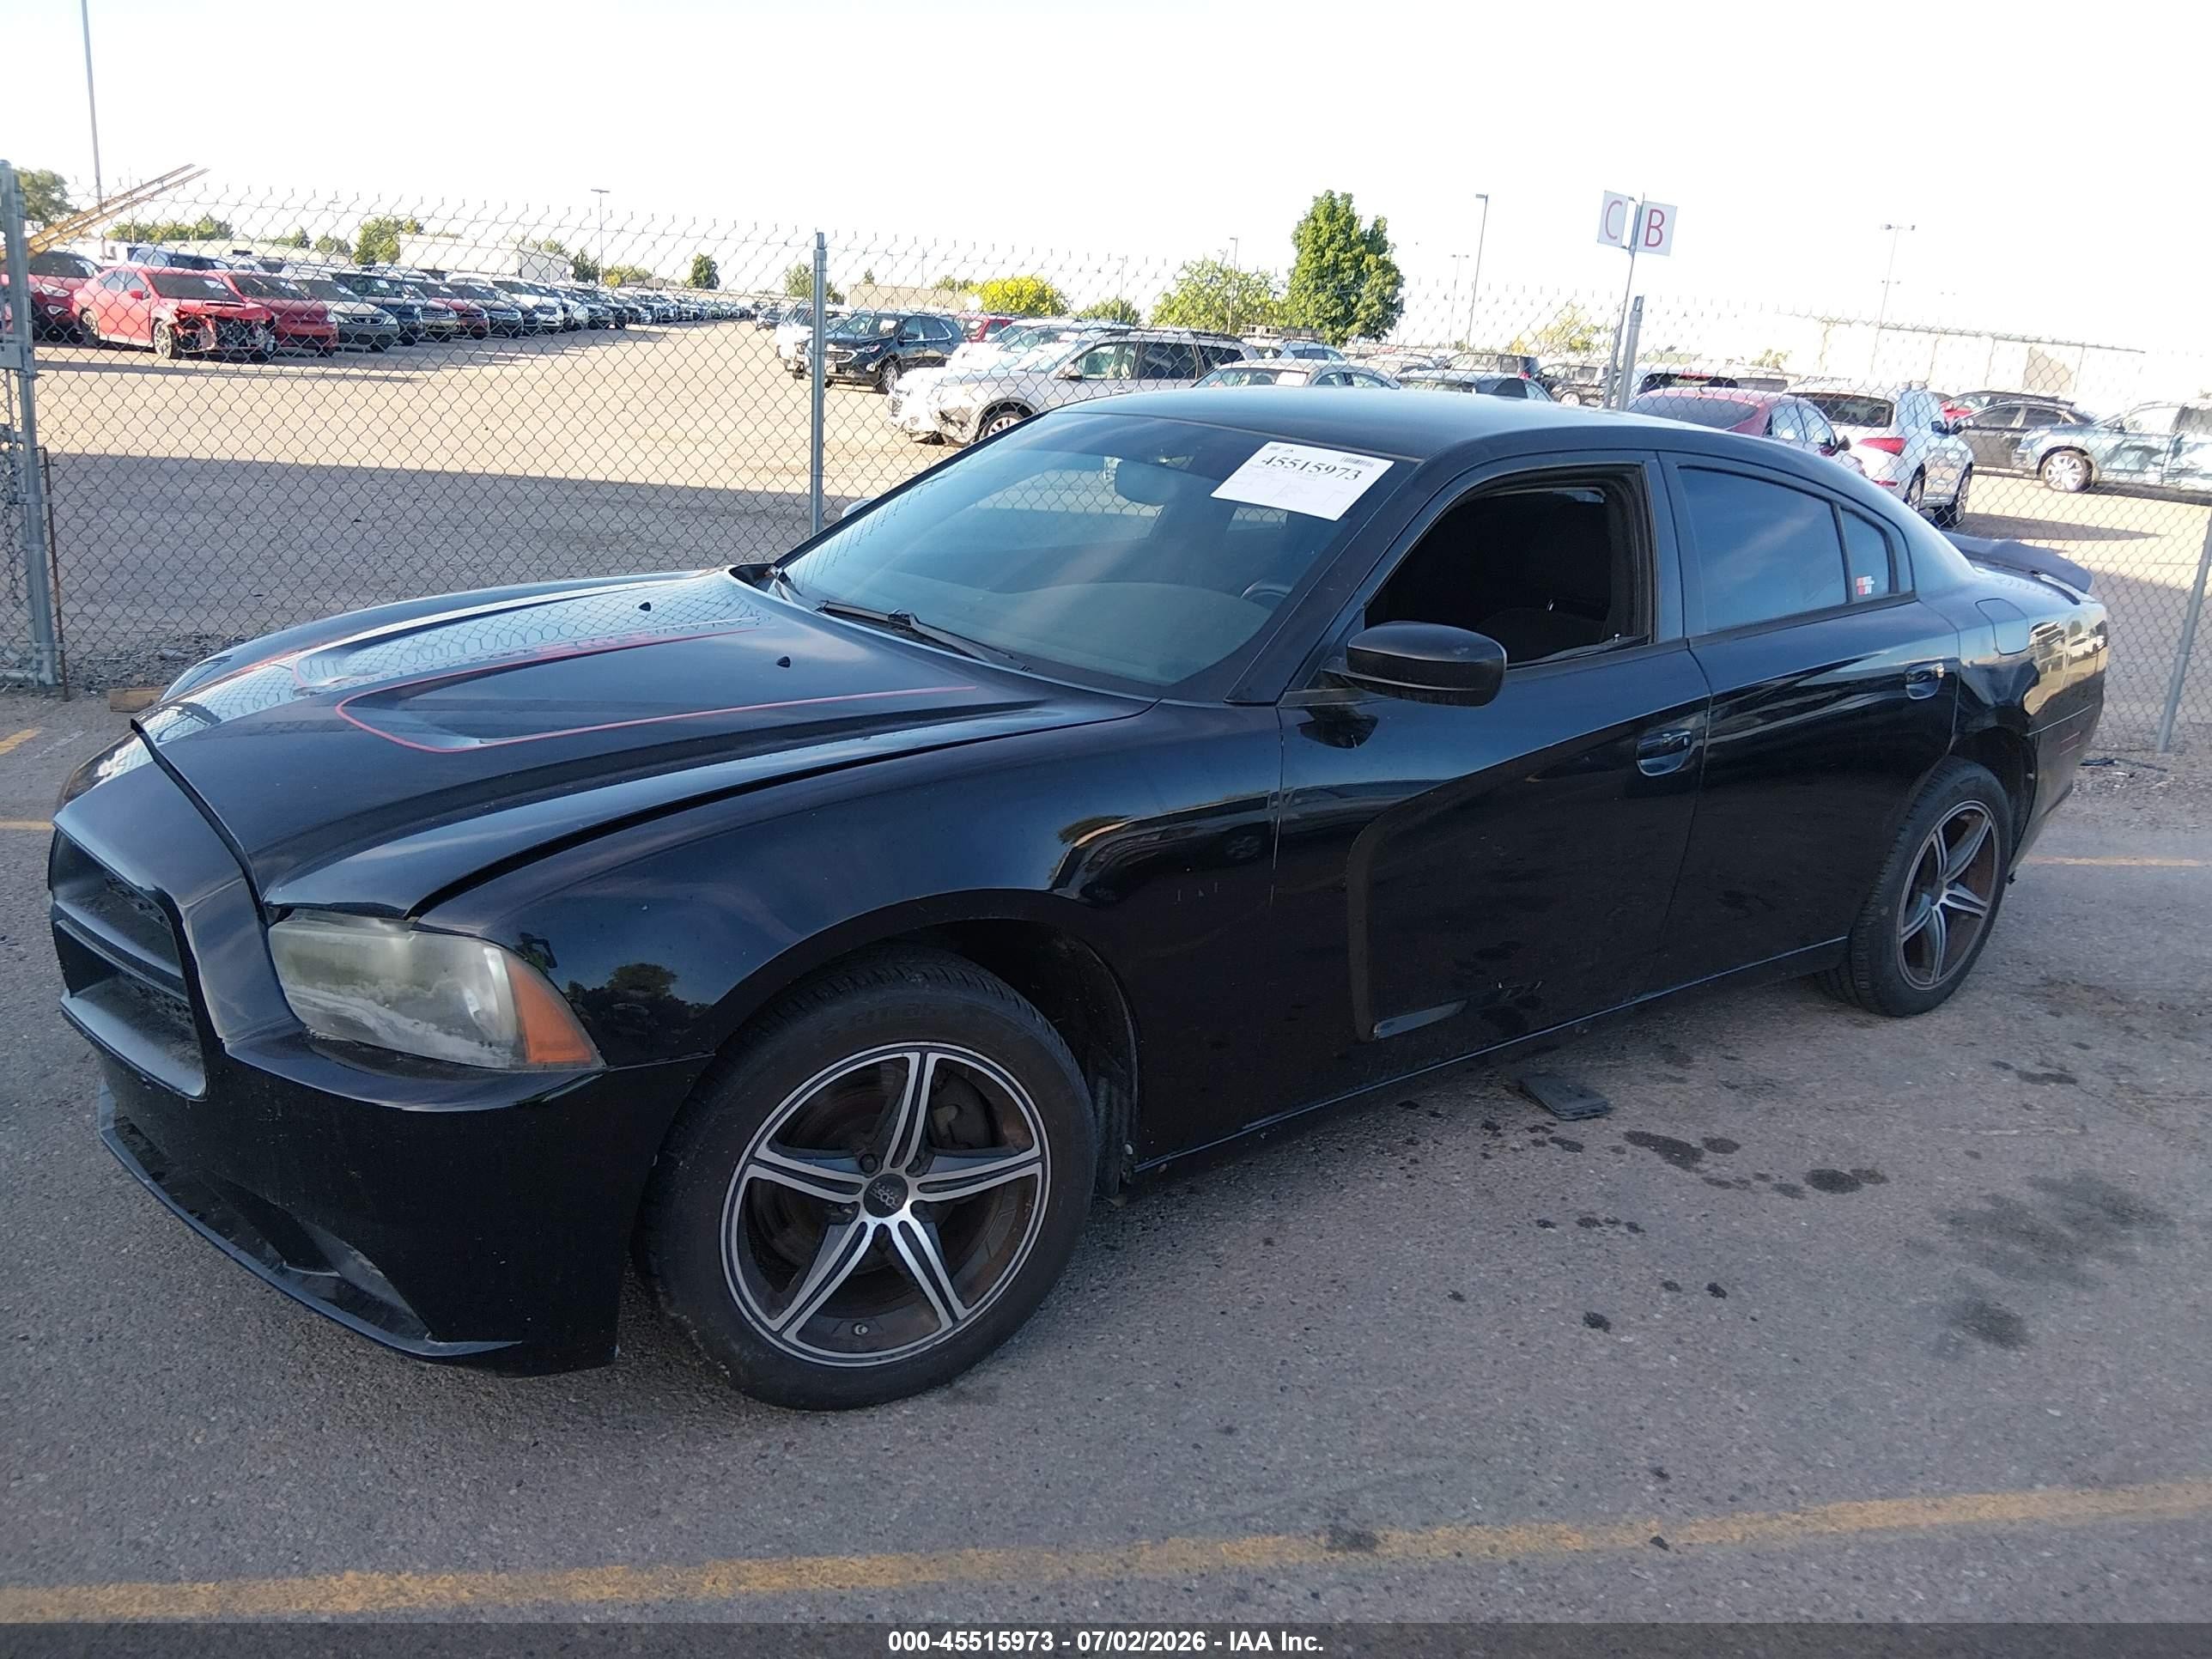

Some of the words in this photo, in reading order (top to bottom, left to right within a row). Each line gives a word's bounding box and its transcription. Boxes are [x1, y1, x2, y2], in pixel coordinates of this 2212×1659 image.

[1606, 200, 1622, 240] C
[1644, 209, 1665, 247] B
[1261, 454, 1364, 481] 45515973
